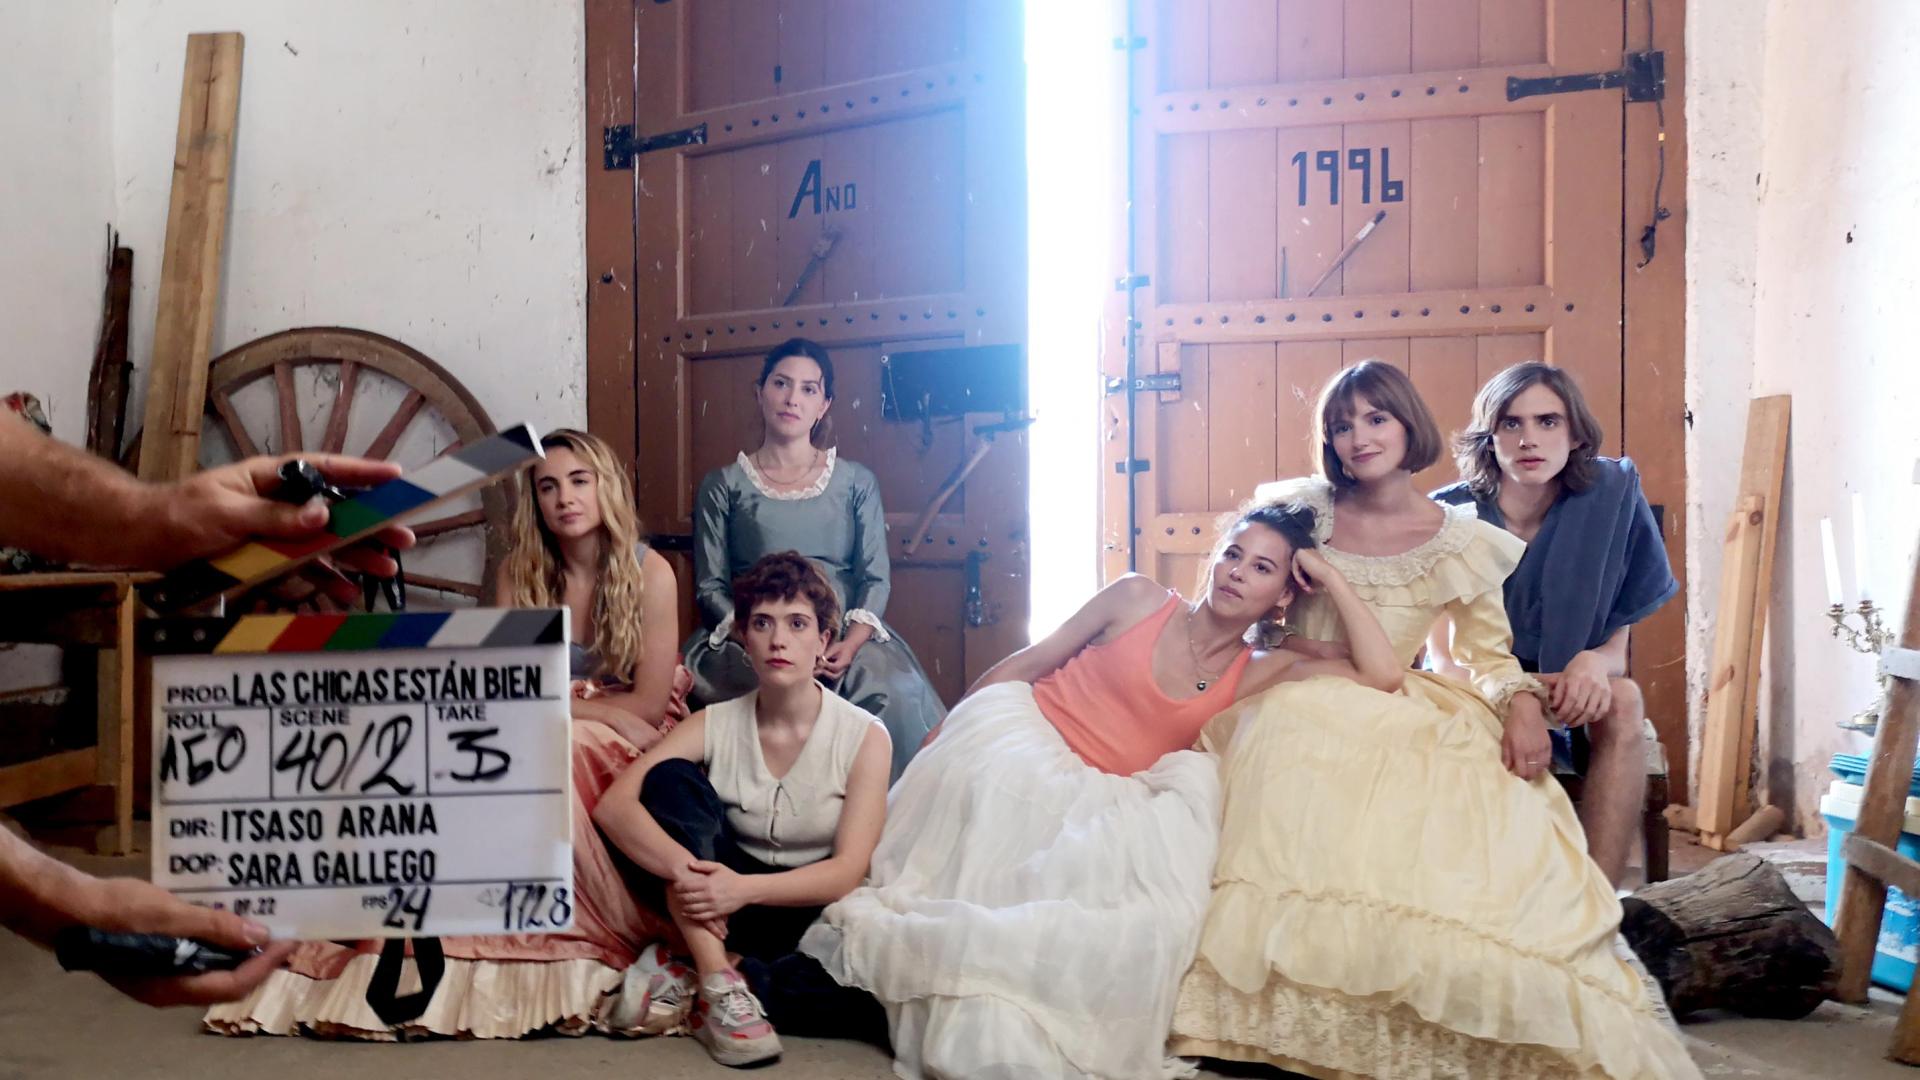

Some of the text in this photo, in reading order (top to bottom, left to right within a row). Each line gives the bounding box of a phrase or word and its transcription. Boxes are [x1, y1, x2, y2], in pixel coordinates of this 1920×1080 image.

[1291, 147, 1404, 206] 1996
[233, 671, 287, 706] LAS
[293, 668, 389, 704] CHICAS
[394, 660, 477, 701] ESTÁN
[484, 665, 541, 699] BIEN
[167, 712, 218, 729] ROLL
[280, 709, 351, 727] SCENE
[434, 704, 487, 721] TAKE
[169, 803, 438, 842] DIR: ITSASO ARANA
[169, 849, 436, 886] DOP: SARA GALLEGO
[383, 885, 431, 931] 24
